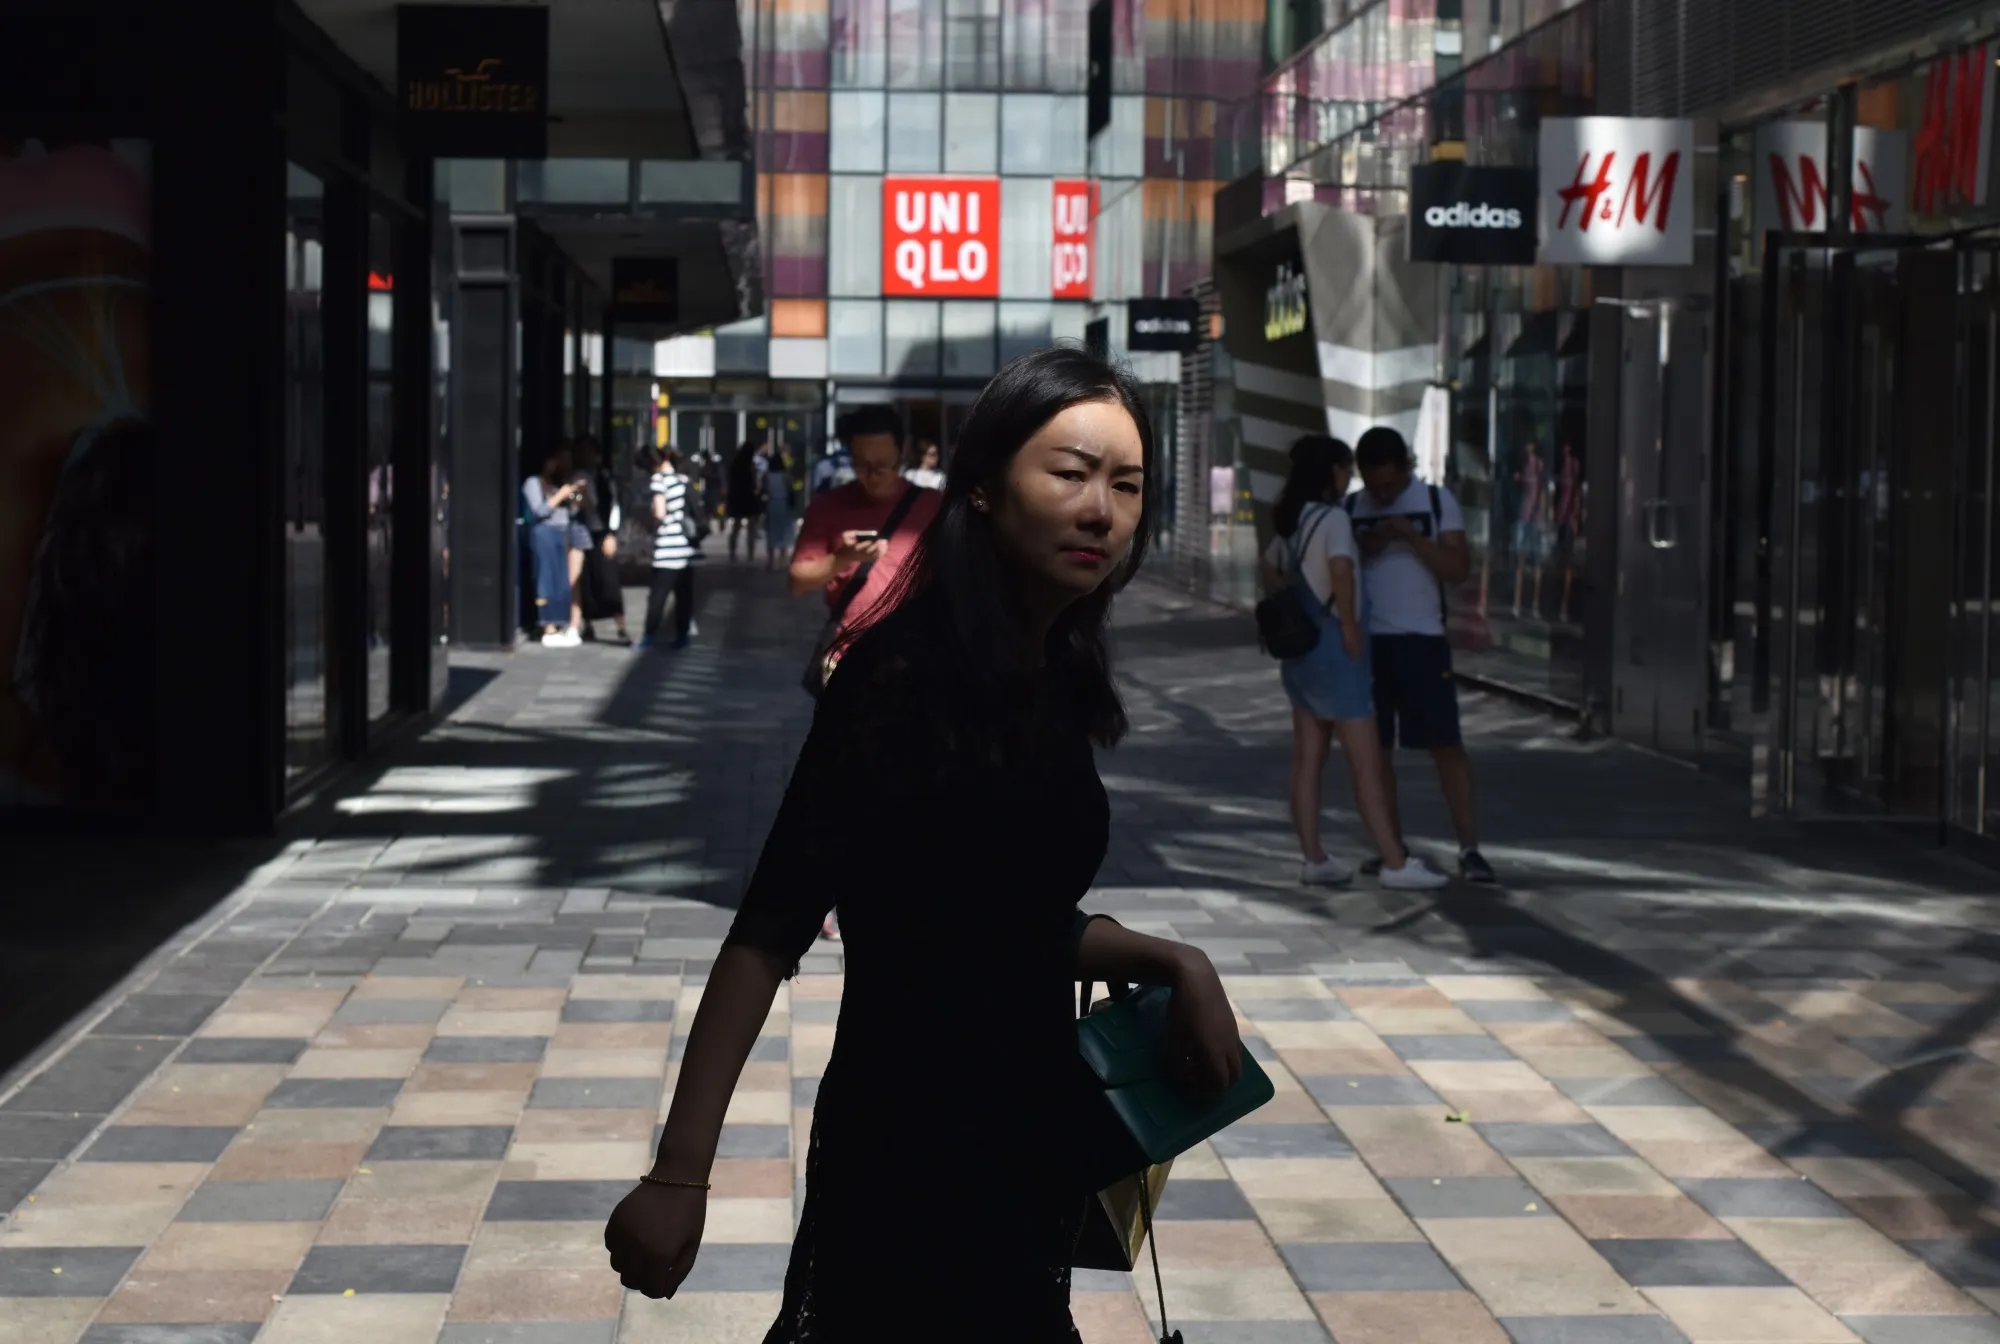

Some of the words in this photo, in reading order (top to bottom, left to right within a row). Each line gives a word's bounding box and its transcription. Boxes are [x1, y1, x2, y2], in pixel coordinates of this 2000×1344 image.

[408, 79, 538, 112] HOLLISTER
[895, 191, 980, 234] UNI
[1558, 151, 1681, 232] H&M
[1425, 201, 1522, 230] adidas
[895, 239, 988, 289] QLO
